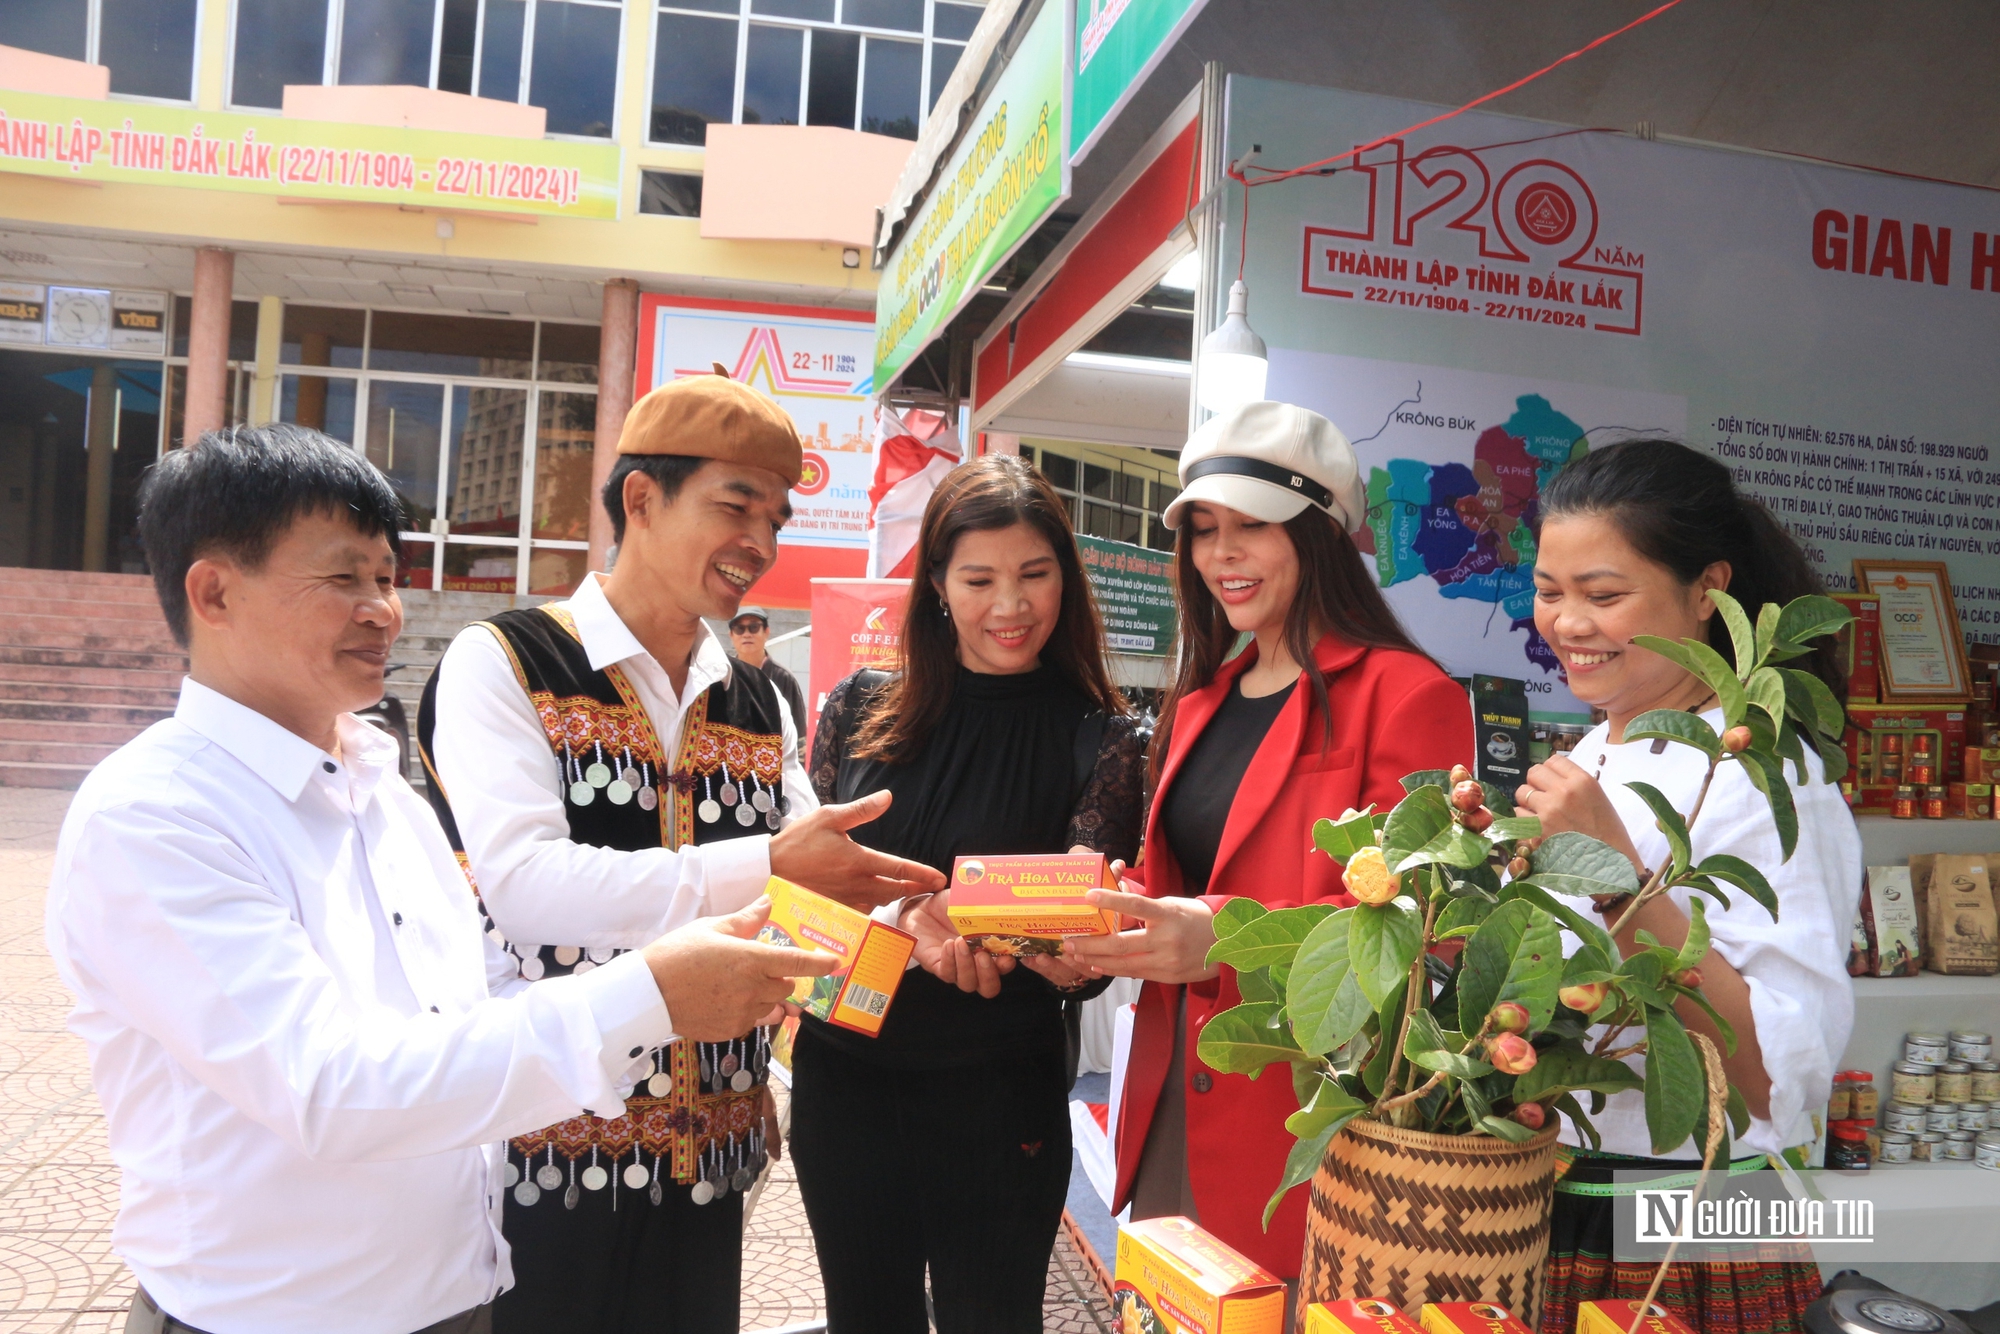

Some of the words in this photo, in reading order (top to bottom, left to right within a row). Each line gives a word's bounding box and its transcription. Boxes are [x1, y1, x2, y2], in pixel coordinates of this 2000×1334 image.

[56, 120, 102, 171] LẬP
[110, 120, 165, 171] TỈNH
[172, 124, 221, 176] ĐẮK
[227, 129, 272, 180] LẮK
[279, 146, 413, 190] (22/11/1904
[436, 158, 579, 205] 22/11/2024)!
[919, 249, 946, 317] OCOP
[964, 193, 981, 265] XÃ
[982, 151, 1022, 242] BUÔN
[1024, 100, 1049, 195] HỒ
[1353, 138, 1599, 267] 120
[1812, 208, 1951, 286] GIAN
[1594, 245, 1644, 269] NĂM
[1326, 249, 1408, 281] THÀNH
[1415, 259, 1459, 291] LẬP
[1466, 264, 1520, 296] TỈNH
[1527, 271, 1575, 304] ĐẮK
[1581, 278, 1623, 311] LẮK
[1364, 286, 1470, 313] 22/11/1904
[1485, 302, 1586, 329] 22/11/2024
[793, 352, 810, 370] 22
[822, 354, 834, 371] 11
[837, 355, 856, 364] 1904
[836, 364, 855, 373] 2024
[1395, 411, 1444, 428] KRÔNG
[1448, 412, 1476, 431] BÚK
[1535, 436, 1571, 448] KRÔNG
[1718, 416, 1742, 435] DIỆN
[1746, 418, 1769, 436] TÍCH
[1772, 424, 1786, 440] TỰ
[1788, 425, 1822, 443] NHIÊN:
[1825, 431, 1855, 447] 62.576
[1858, 435, 1874, 451] HA,
[1877, 435, 1897, 451] DÂN
[1900, 435, 1916, 454] SỐ:
[1920, 442, 1954, 458] 198.929
[1957, 445, 1988, 461] NGƯỜI
[1542, 447, 1563, 458] BÚK
[1717, 436, 1745, 458] TỔNG
[1749, 441, 1763, 460] SỐ
[1766, 447, 1787, 462] ĐƠN
[1791, 451, 1800, 467] VỊ
[1803, 450, 1830, 467] HÀNH
[1834, 454, 1867, 472] CHÍNH:
[1871, 461, 1875, 473] 1
[1879, 461, 1894, 478] THỊ
[1897, 459, 1923, 478] TRẤN
[1935, 468, 1945, 480] 15
[1948, 466, 1963, 484] XÃ,
[1967, 467, 1983, 484] VỚI
[1496, 466, 1509, 475] EA
[1511, 466, 1531, 477] PHÊ
[830, 484, 867, 500] năm
[1754, 469, 1790, 487] KRÔNG
[1794, 470, 1814, 490] PẮC
[1817, 475, 1831, 491] CÓ
[1835, 476, 1854, 494] THẾ
[1857, 482, 1885, 499] MẠNH
[1888, 485, 1922, 501] TRONG
[1925, 487, 1945, 503] CÁC
[1948, 489, 1971, 506] LĨNH
[1974, 493, 1994, 510] VỰC
[1482, 499, 1496, 508] AN
[1436, 507, 1450, 517] EA
[1770, 497, 1779, 513] VỊ
[1782, 496, 1798, 512] TRÍ
[1801, 500, 1816, 516] ĐỊA
[1820, 500, 1835, 518] LÝ,
[1838, 504, 1862, 519] GIAO
[1865, 505, 1898, 522] THÔNG
[1902, 509, 1934, 528] THUẬN
[1937, 513, 1953, 530] LỢI
[1956, 512, 1969, 529] VÀ
[1972, 517, 1992, 531] CON
[1427, 519, 1457, 530] YÔNG
[1793, 519, 1813, 538] THỦ
[1816, 522, 1836, 540] PHỦ
[1862, 528, 1892, 545] RIÊNG
[1895, 529, 1915, 547] CỦA
[1918, 533, 1937, 549] TÂY
[1940, 537, 1983, 555] NGUYÊN,
[1522, 541, 1536, 549] EA
[1082, 545, 1099, 565] CÂU
[1100, 551, 1114, 572] LẠC
[1115, 551, 1126, 575] BỘ
[1127, 553, 1147, 574] BÓNG
[1399, 547, 1408, 560] EA
[1381, 557, 1390, 571] EA
[1107, 576, 1124, 588] XUYÊN
[1477, 576, 1497, 587] TÂN
[1826, 571, 1847, 589] CÒN
[1962, 586, 1985, 601] LỊCH
[1510, 600, 1523, 610] EA
[1894, 613, 1923, 622] OCOP
[1971, 607, 1991, 624] CÁC
[1500, 715, 1522, 726] THANH
[987, 872, 1014, 886] TRÀ
[1018, 872, 1050, 884] HOA
[1055, 871, 1095, 885] VÀNG
